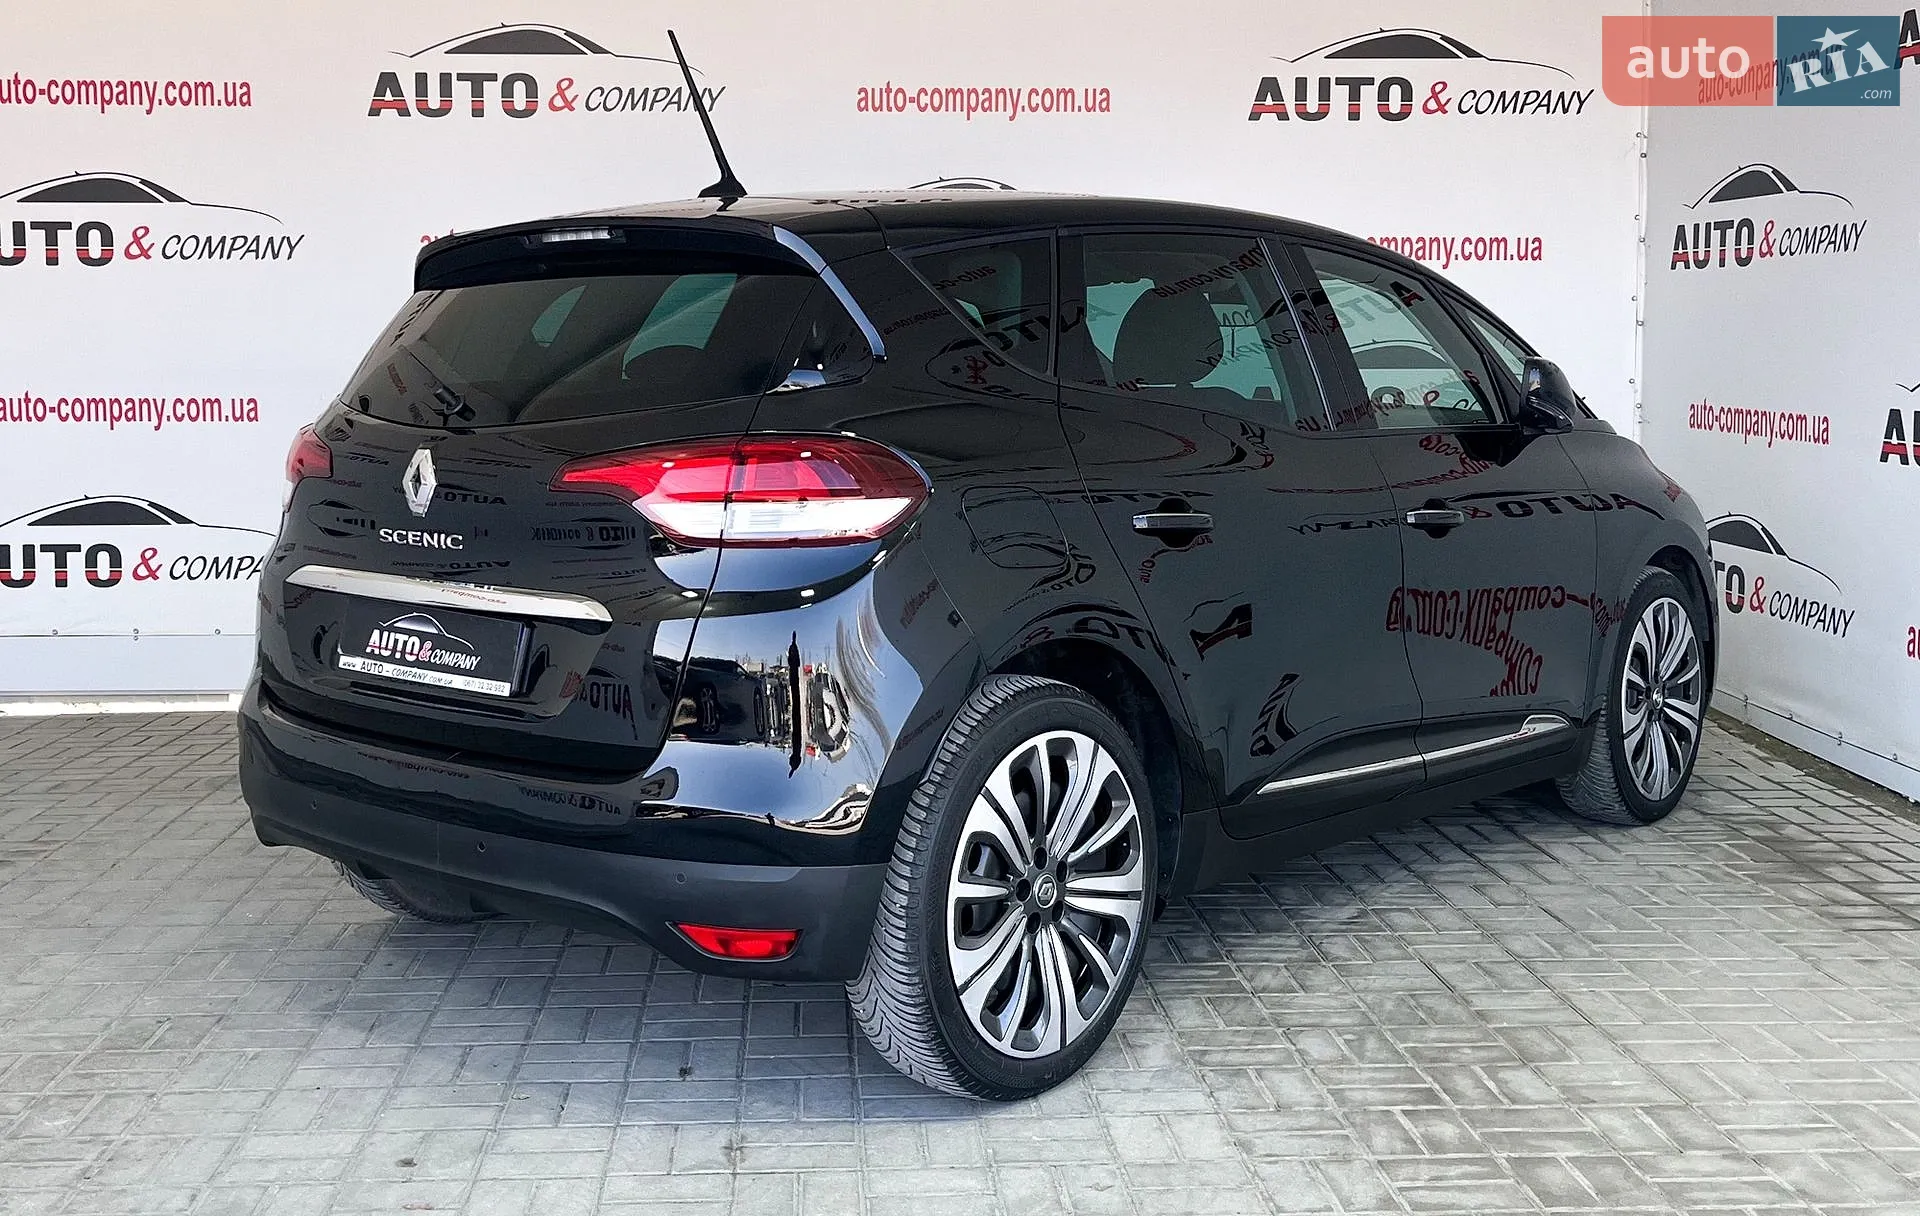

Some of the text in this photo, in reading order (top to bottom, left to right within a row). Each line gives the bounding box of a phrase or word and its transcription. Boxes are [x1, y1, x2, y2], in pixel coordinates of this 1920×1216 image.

[367, 72, 726, 118] AUTO & COMPANY
[857, 81, 1111, 122] auto-company.com.ua
[1248, 76, 1594, 121] AUTO & COMPANY
[124, 225, 154, 260] &
[161, 234, 305, 260] COMPANY
[1670, 218, 1867, 270] AUTO & COMPANY
[1689, 398, 1829, 448] auto-company.com.ua
[379, 528, 463, 550] SCENIC
[132, 547, 163, 581] &
[1750, 576, 1767, 614] &
[1769, 591, 1855, 639] COMPANY
[360, 660, 384, 674] AUTO
[366, 629, 481, 671] AUTO & COMPANY
